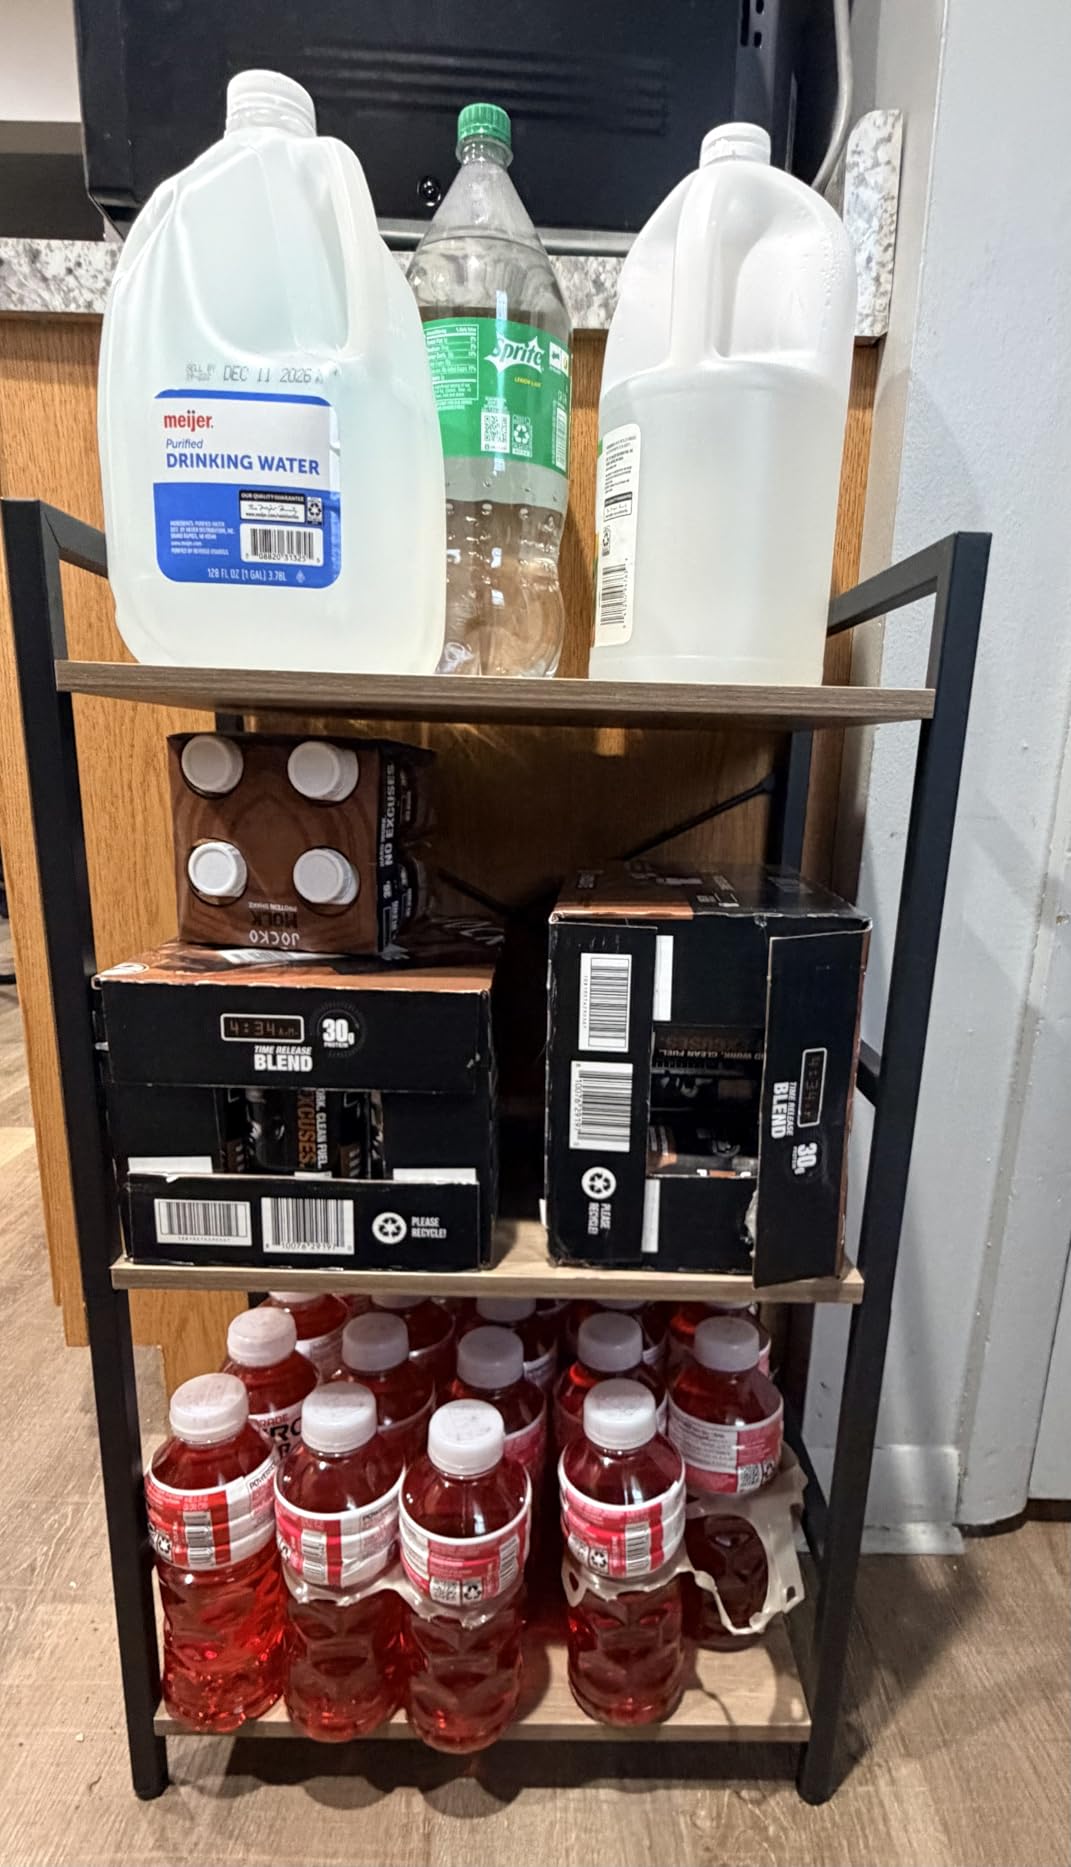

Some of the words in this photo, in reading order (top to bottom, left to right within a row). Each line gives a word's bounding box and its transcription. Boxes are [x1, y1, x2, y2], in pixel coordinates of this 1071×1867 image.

[491, 338, 542, 366] Sprite
[224, 365, 249, 382] DEC
[257, 368, 271, 383] 11
[279, 367, 312, 384] 2026
[166, 438, 204, 449] Purified
[166, 453, 253, 470] DRINKING
[258, 456, 320, 475] WATER
[221, 568, 229, 579] FL
[230, 569, 240, 579] OZ
[254, 1045, 274, 1054] TIME
[275, 1046, 312, 1055] RELEASE
[254, 1054, 313, 1072] BLEND
[788, 1082, 797, 1101] TIME
[771, 1082, 789, 1139] BLEND
[786, 1102, 796, 1136] RELEASE
[316, 1112, 327, 1143] CLEAN
[317, 1144, 328, 1169] FUEL.
[411, 1216, 440, 1227] PLEASE
[600, 1203, 611, 1229] PLEASE
[411, 1227, 447, 1238] RECYCLE!
